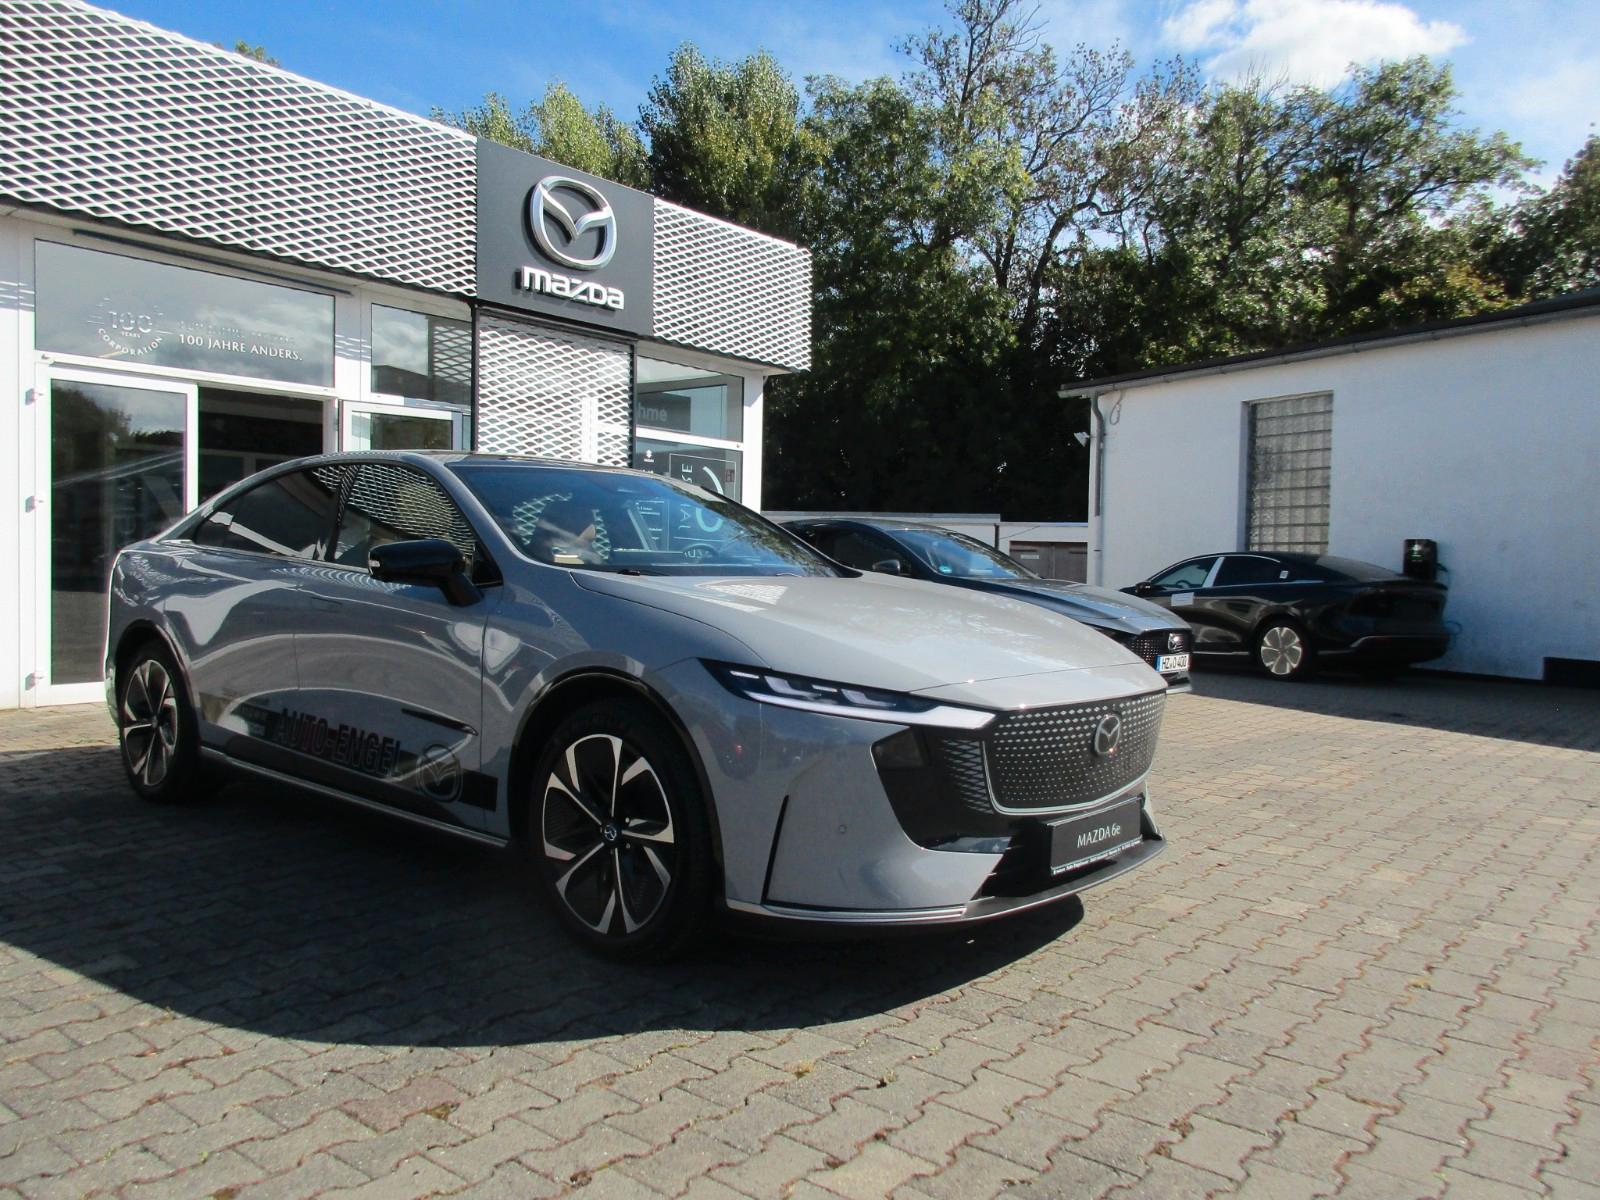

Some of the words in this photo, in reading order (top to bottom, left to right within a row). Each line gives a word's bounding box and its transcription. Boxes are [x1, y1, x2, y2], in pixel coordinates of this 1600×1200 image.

[179, 333, 203, 346] 100
[207, 338, 247, 353] JAHRE
[250, 344, 302, 361] ANDERS.
[274, 707, 403, 779] AUTO-ENGEL
